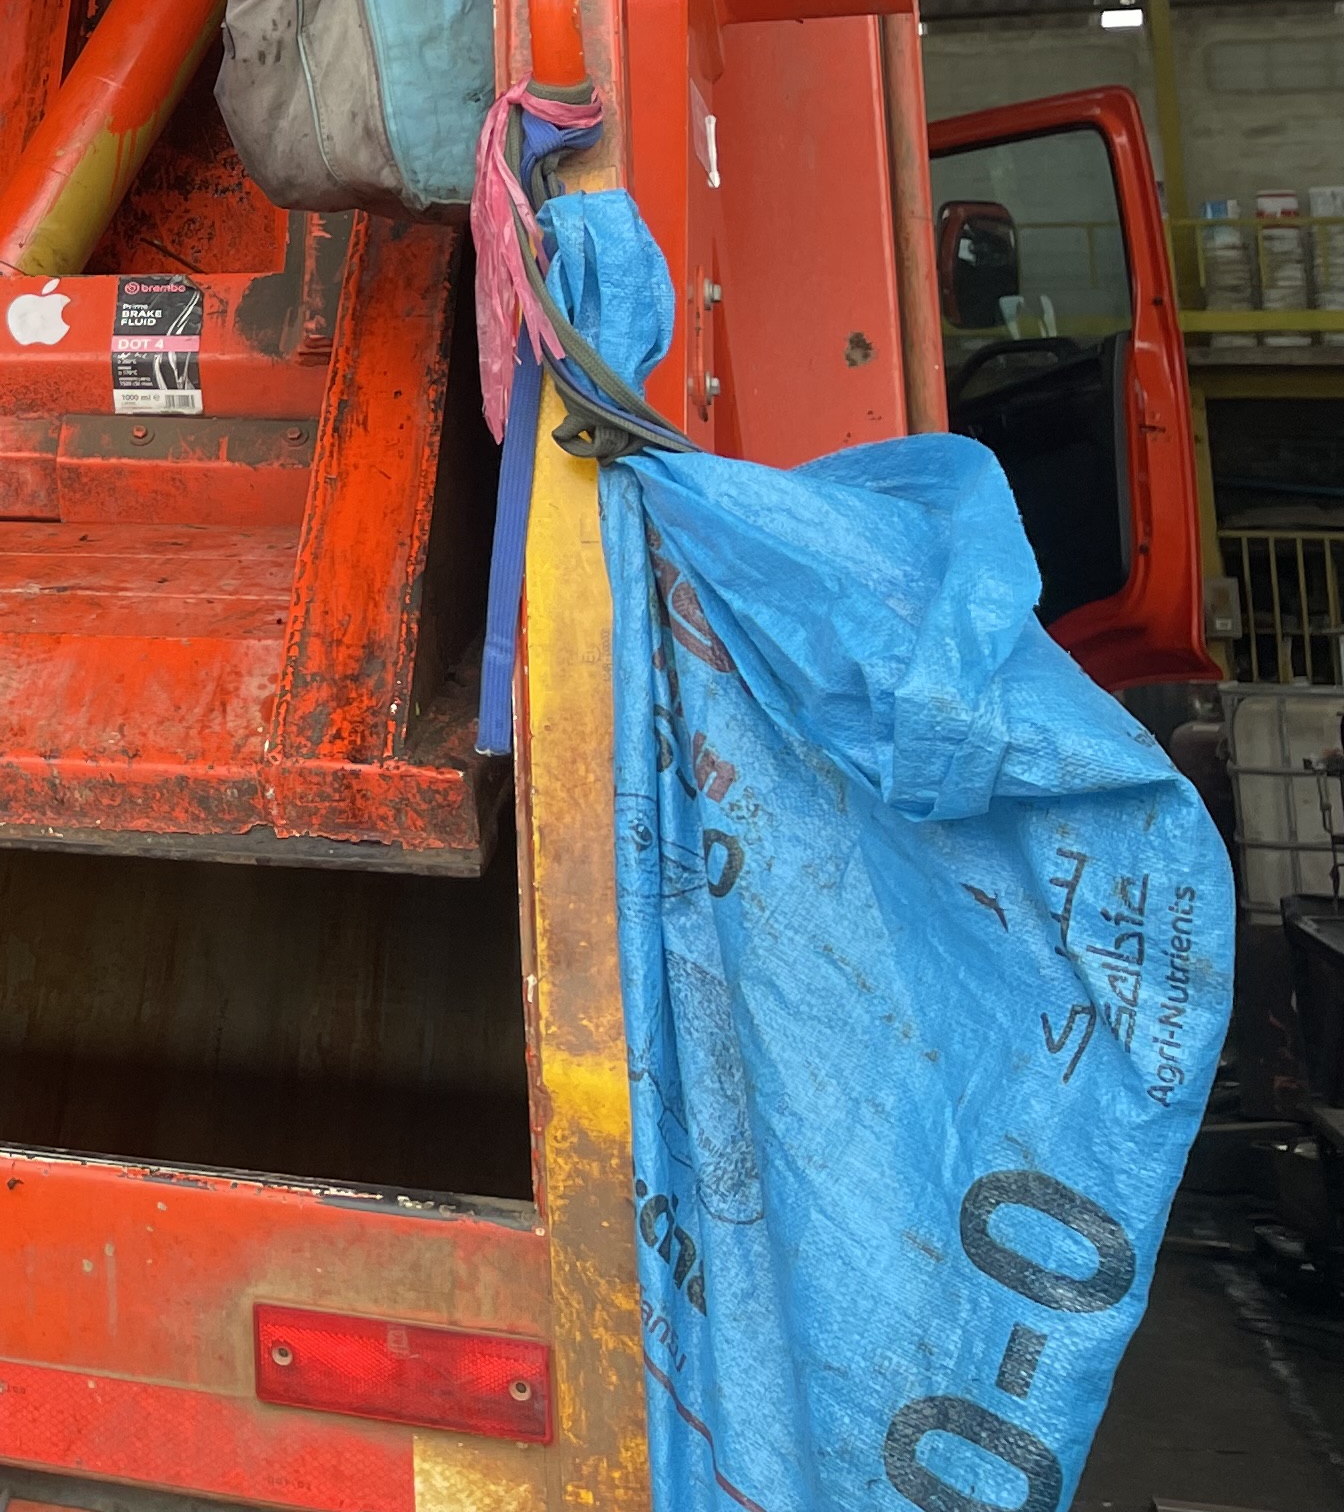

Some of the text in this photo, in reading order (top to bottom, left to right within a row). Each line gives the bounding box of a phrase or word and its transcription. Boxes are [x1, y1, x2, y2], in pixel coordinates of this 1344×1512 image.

[140, 283, 186, 293] brembo
[122, 310, 162, 318] BRAKE
[121, 318, 156, 326] FLUID
[118, 339, 164, 350] DOT 4
[1146, 884, 1196, 1108] Agri-Nutrients
